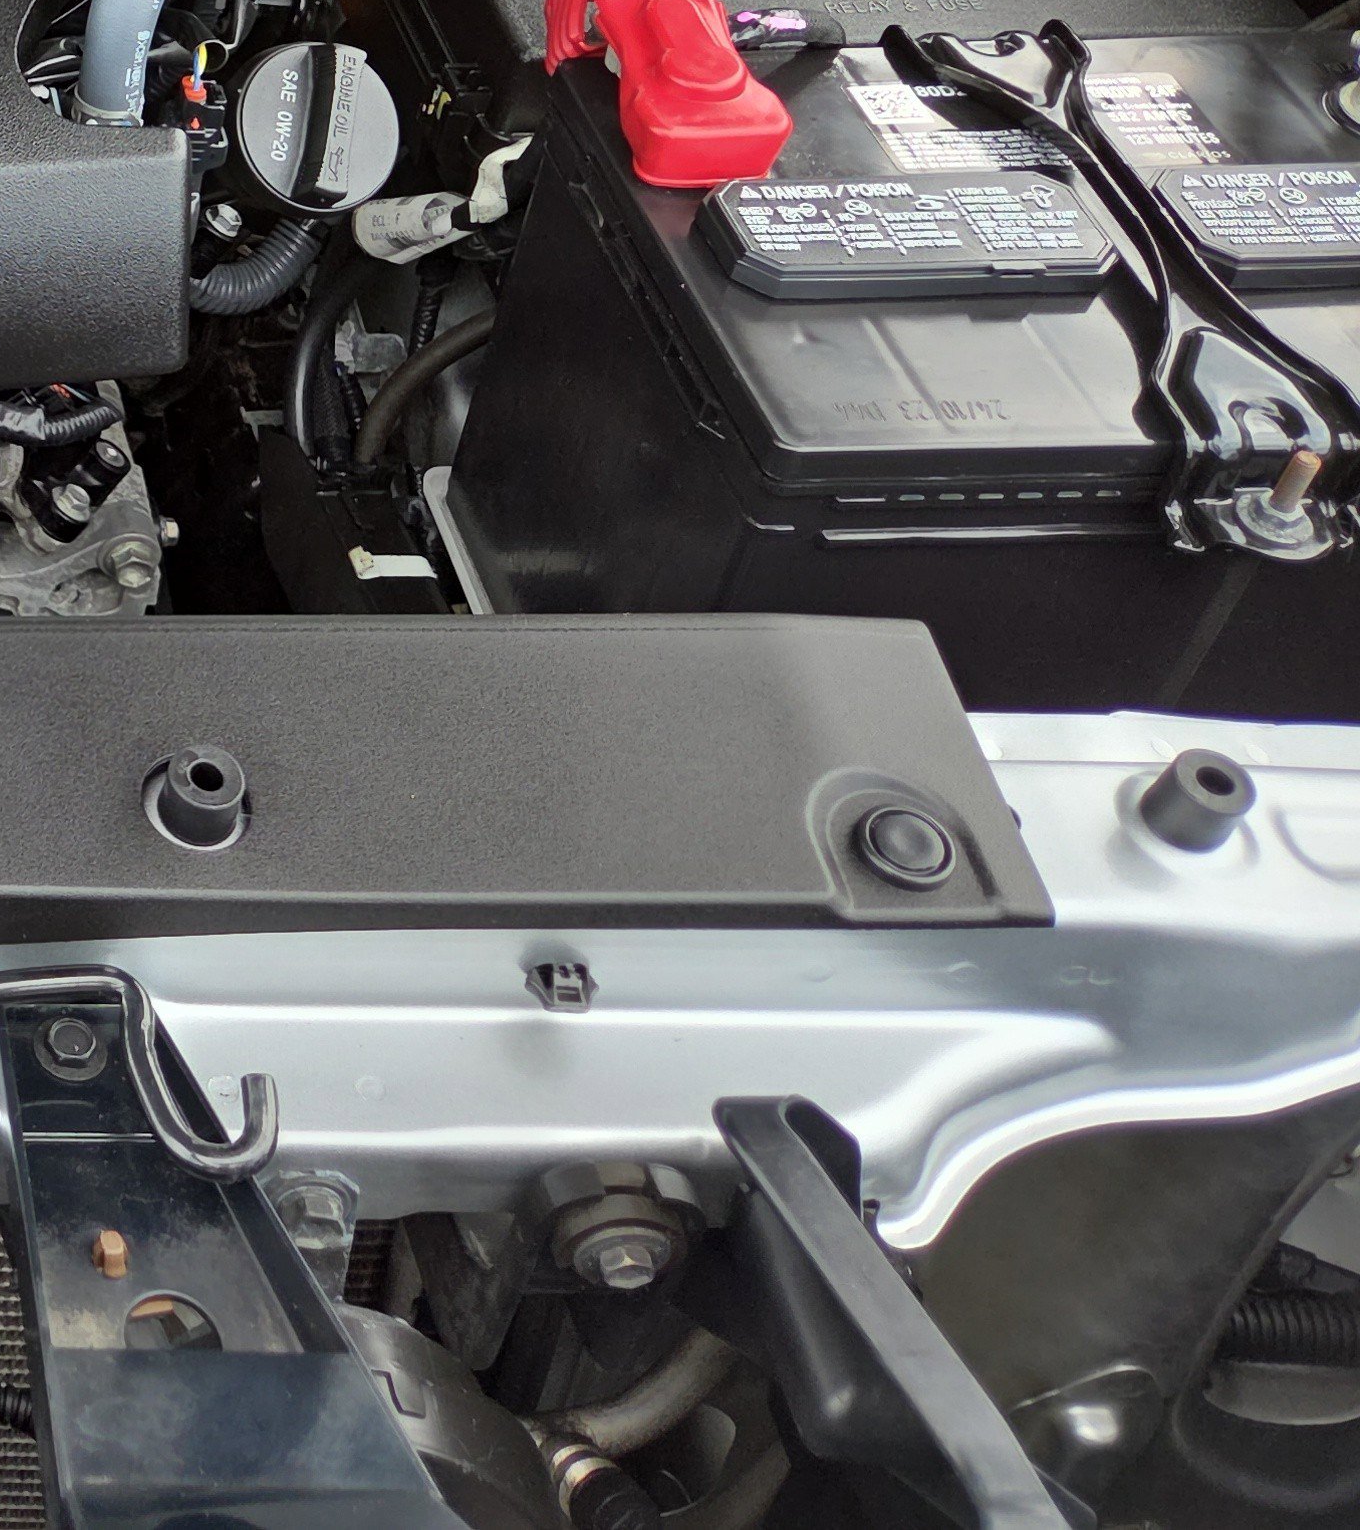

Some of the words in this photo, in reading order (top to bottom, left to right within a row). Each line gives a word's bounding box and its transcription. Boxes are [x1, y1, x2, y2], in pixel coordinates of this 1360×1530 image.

[824, 0, 892, 15] RELAY
[280, 69, 299, 103] SAE
[336, 54, 357, 113] ENGINE
[913, 85, 968, 98] 80D
[333, 114, 348, 138] OIL
[270, 111, 294, 162] 0W-20
[1154, 132, 1221, 145] MINUTES
[1201, 173, 1275, 188] DANGER
[1286, 170, 1357, 186] POISON
[759, 185, 833, 200] DANGER
[844, 183, 915, 198] POISON
